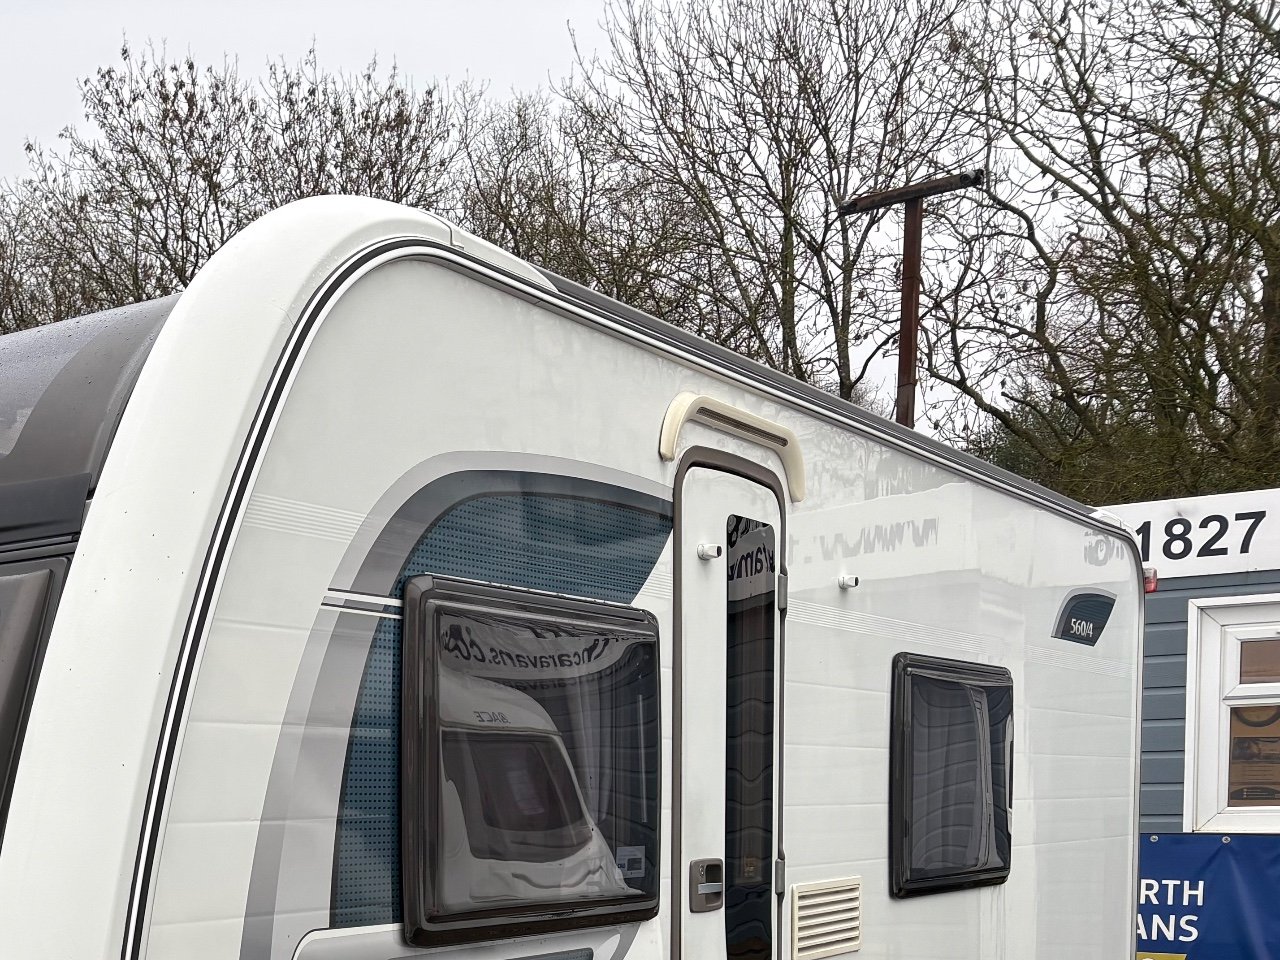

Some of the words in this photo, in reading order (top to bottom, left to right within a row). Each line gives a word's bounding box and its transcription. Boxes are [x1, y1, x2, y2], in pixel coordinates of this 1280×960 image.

[1136, 510, 1267, 563] 1827
[1070, 617, 1094, 638] 560/4
[1139, 878, 1205, 906] RTH
